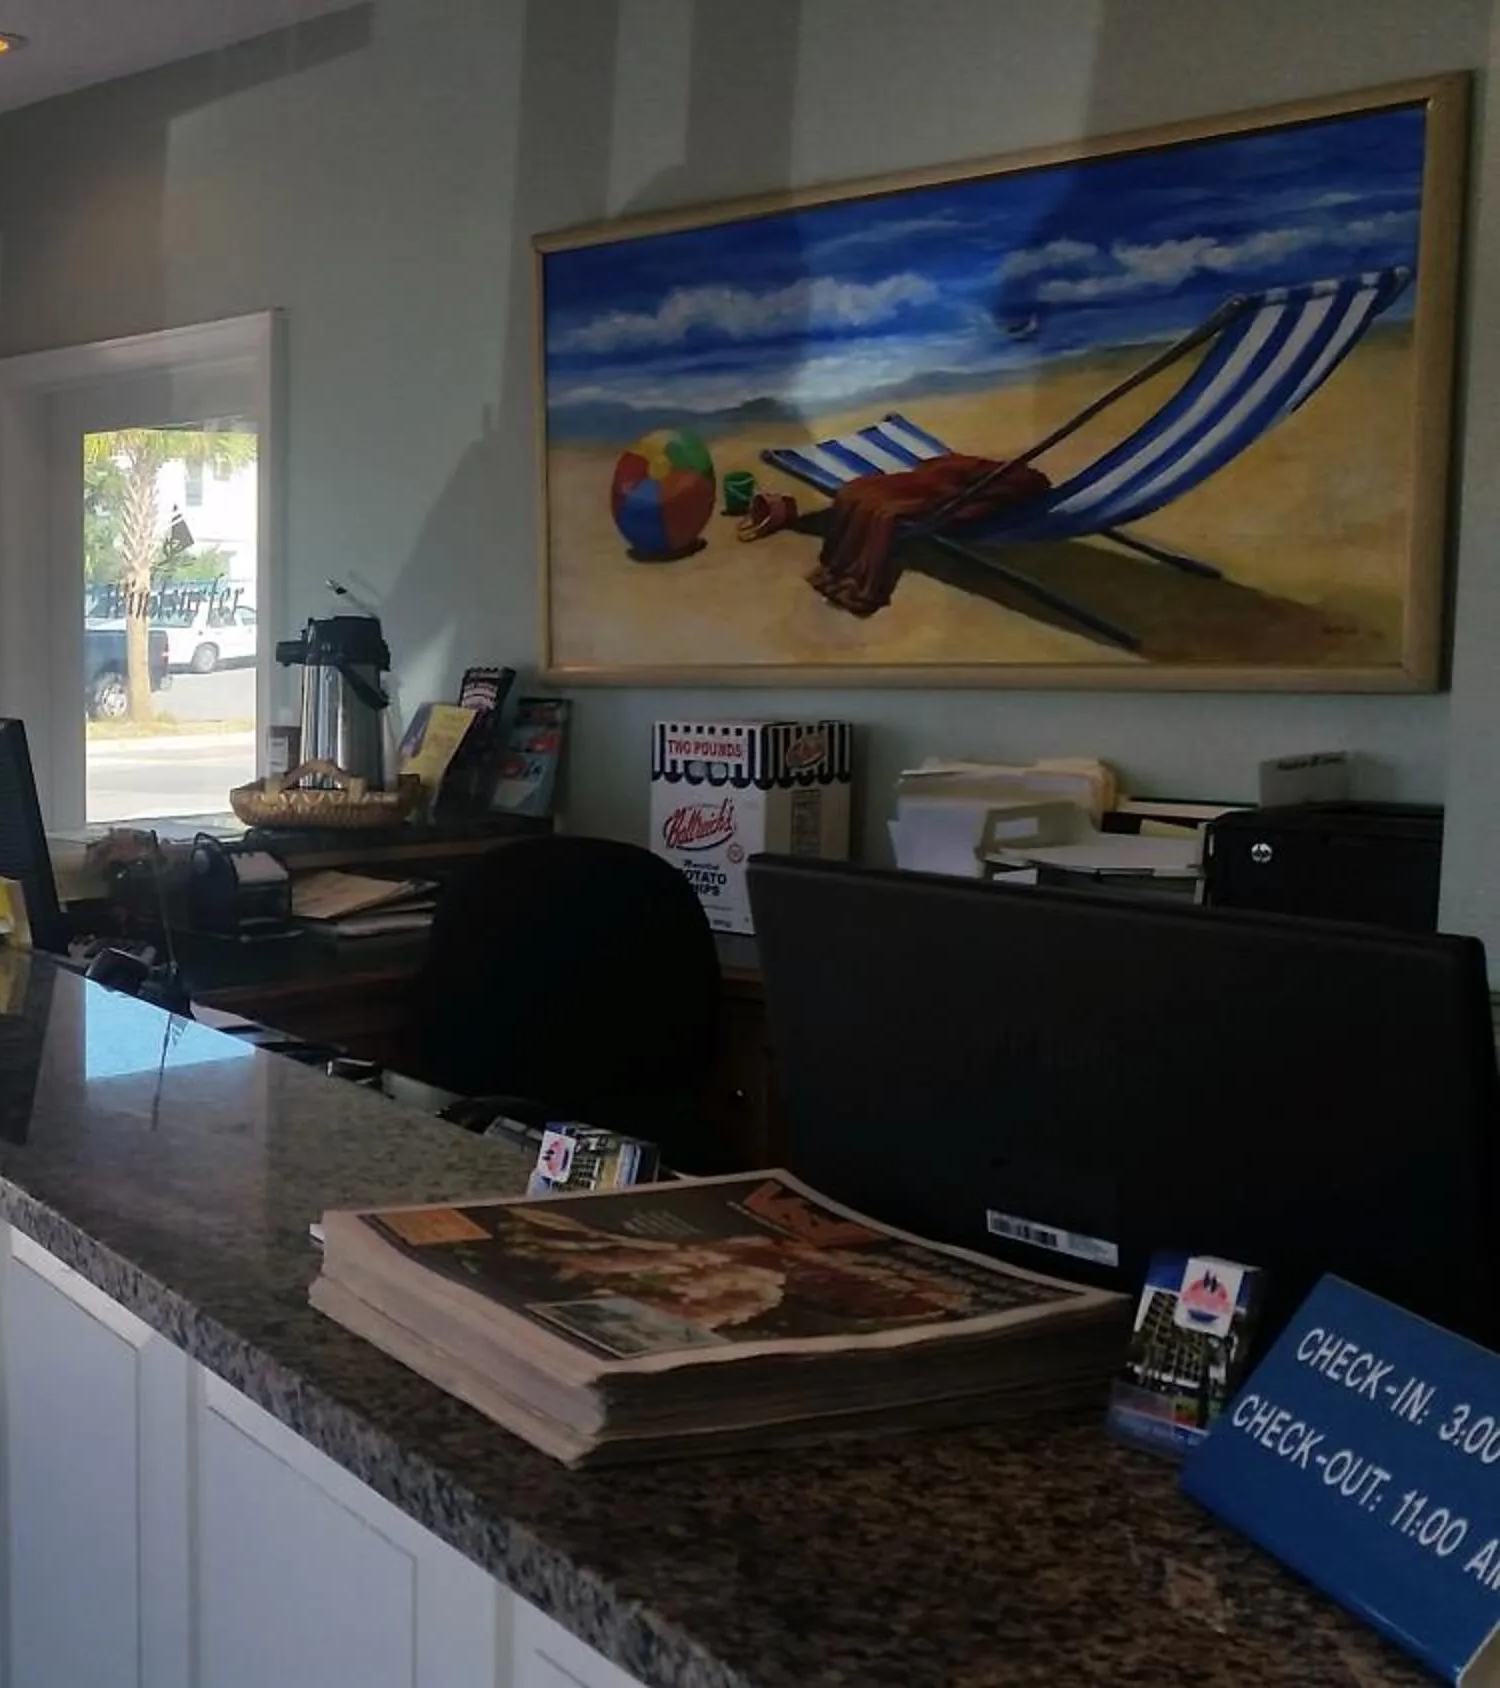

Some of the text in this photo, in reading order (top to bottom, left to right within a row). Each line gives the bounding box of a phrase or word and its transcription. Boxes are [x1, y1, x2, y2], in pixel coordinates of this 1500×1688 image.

[667, 739, 742, 758] TWO POUNDS
[687, 869, 727, 886] OTATO
[1296, 1327, 1437, 1425] CHECK-IN:
[1232, 1395, 1392, 1513] CHECK-OUT:
[1389, 1489, 1469, 1557] 11:00
